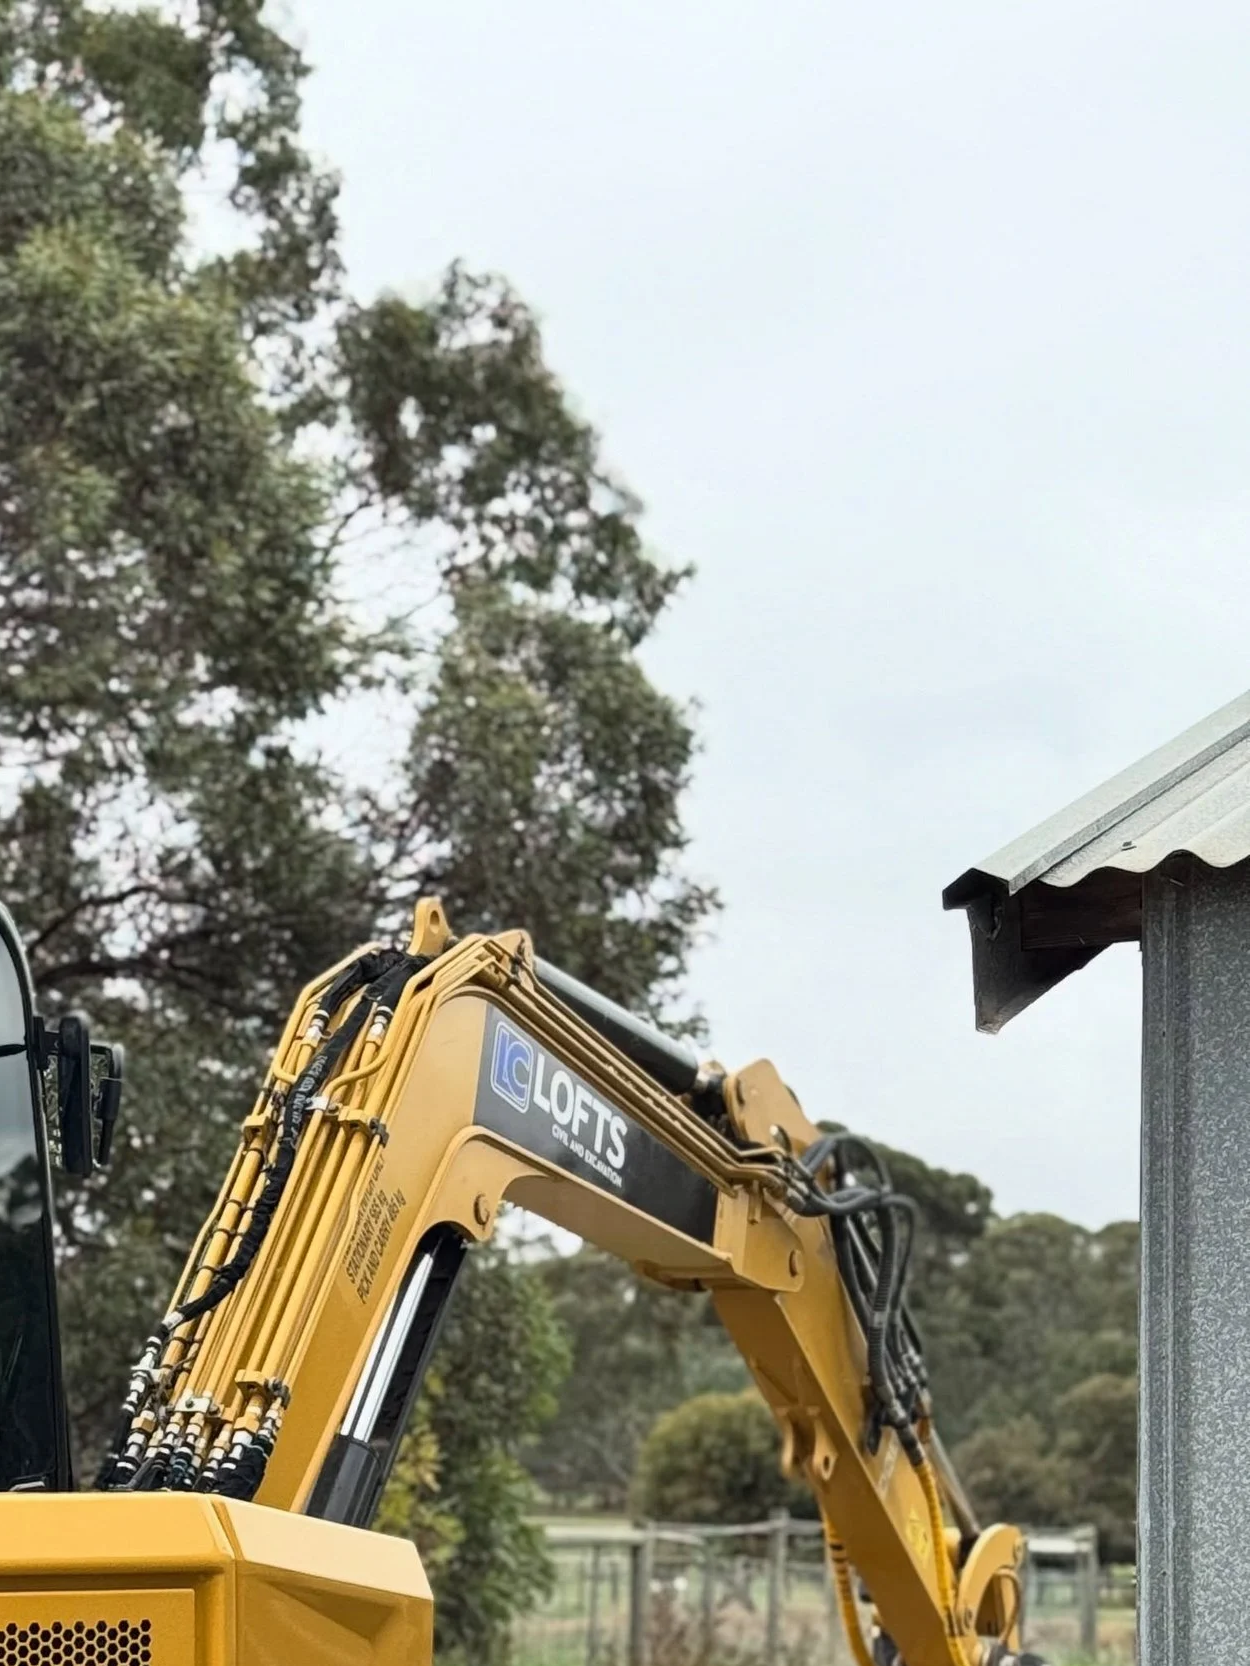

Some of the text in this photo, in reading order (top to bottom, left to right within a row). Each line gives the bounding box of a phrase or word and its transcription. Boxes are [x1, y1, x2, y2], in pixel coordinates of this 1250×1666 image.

[533, 1052, 628, 1169] LOFTS
[552, 1124, 623, 1188] CIVIL AND EXCAVATION
[346, 1215, 375, 1285] STATIONARY
[356, 1270, 372, 1305] PICK
[366, 1250, 380, 1280] AND
[374, 1214, 392, 1258] CARRY
